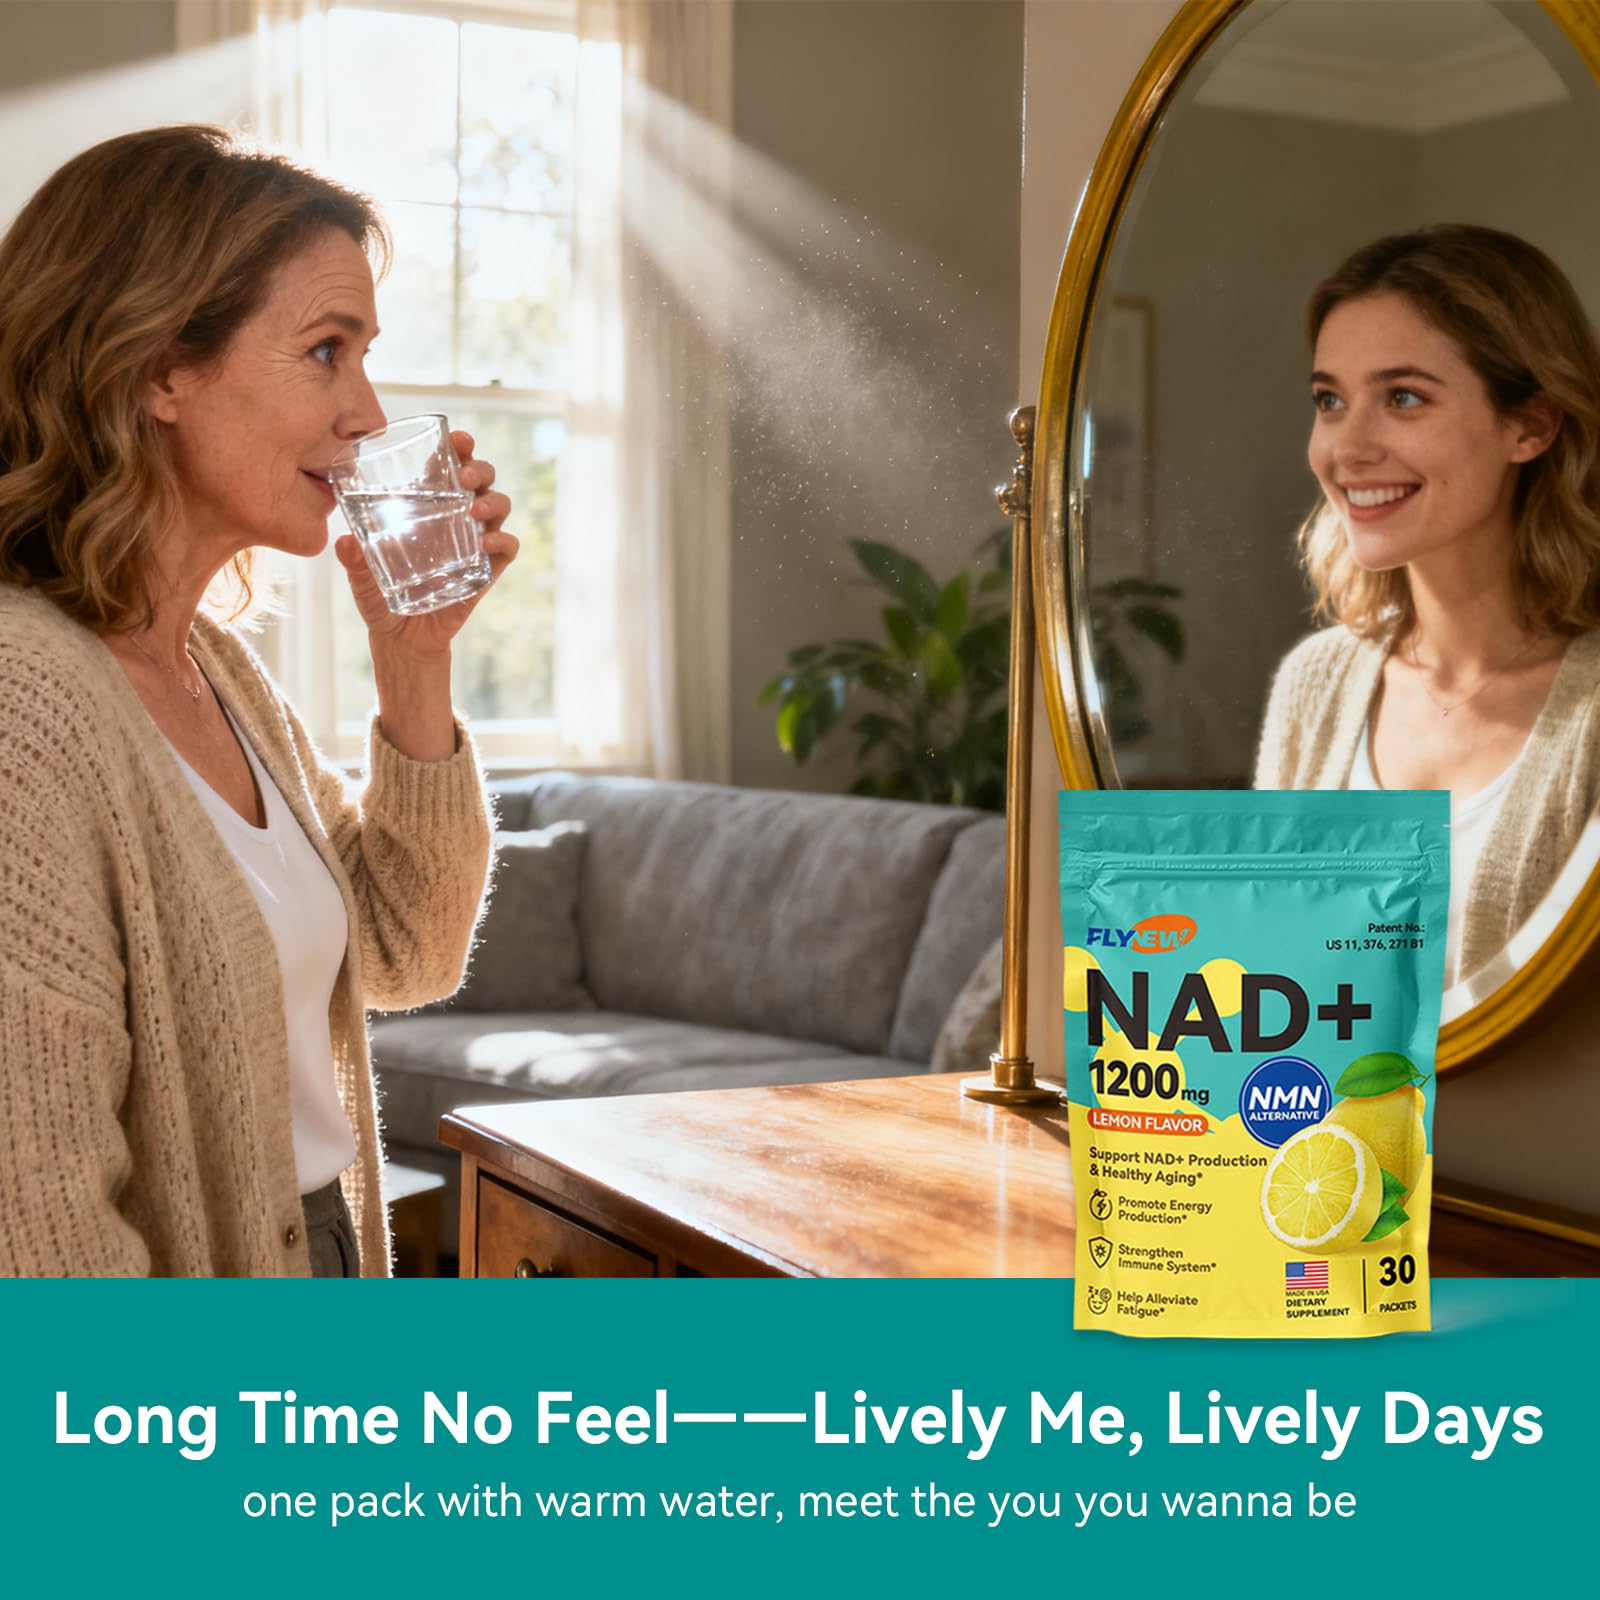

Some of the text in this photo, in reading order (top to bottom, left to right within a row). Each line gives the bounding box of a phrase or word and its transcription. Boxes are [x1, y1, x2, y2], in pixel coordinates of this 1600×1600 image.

[1368, 922, 1425, 933] Patent No.:
[1326, 938, 1424, 952] US 11, 376, 271 B1
[1087, 968, 1372, 1053] NAD+
[1249, 1085, 1322, 1110] NMN
[1093, 1112, 1203, 1132] LEMON FLAVOR
[1249, 1110, 1319, 1121] ALTERNATIVE
[1089, 1146, 1267, 1167] Support NAD+ Production
[1089, 1164, 1099, 1176] &
[1102, 1166, 1152, 1184] Healthy
[1118, 1196, 1213, 1214] Promote Energy
[1118, 1244, 1183, 1260] Strengthen
[1118, 1258, 1164, 1271] Immune
[1379, 1254, 1416, 1287] 30
[1117, 1290, 1199, 1306] Help Alleviate
[1316, 1289, 1330, 1297] USA
[1286, 1298, 1327, 1307] DIETARY
[1379, 1300, 1417, 1312] PACKETS
[1286, 1307, 1350, 1318] SUPPLEMENT
